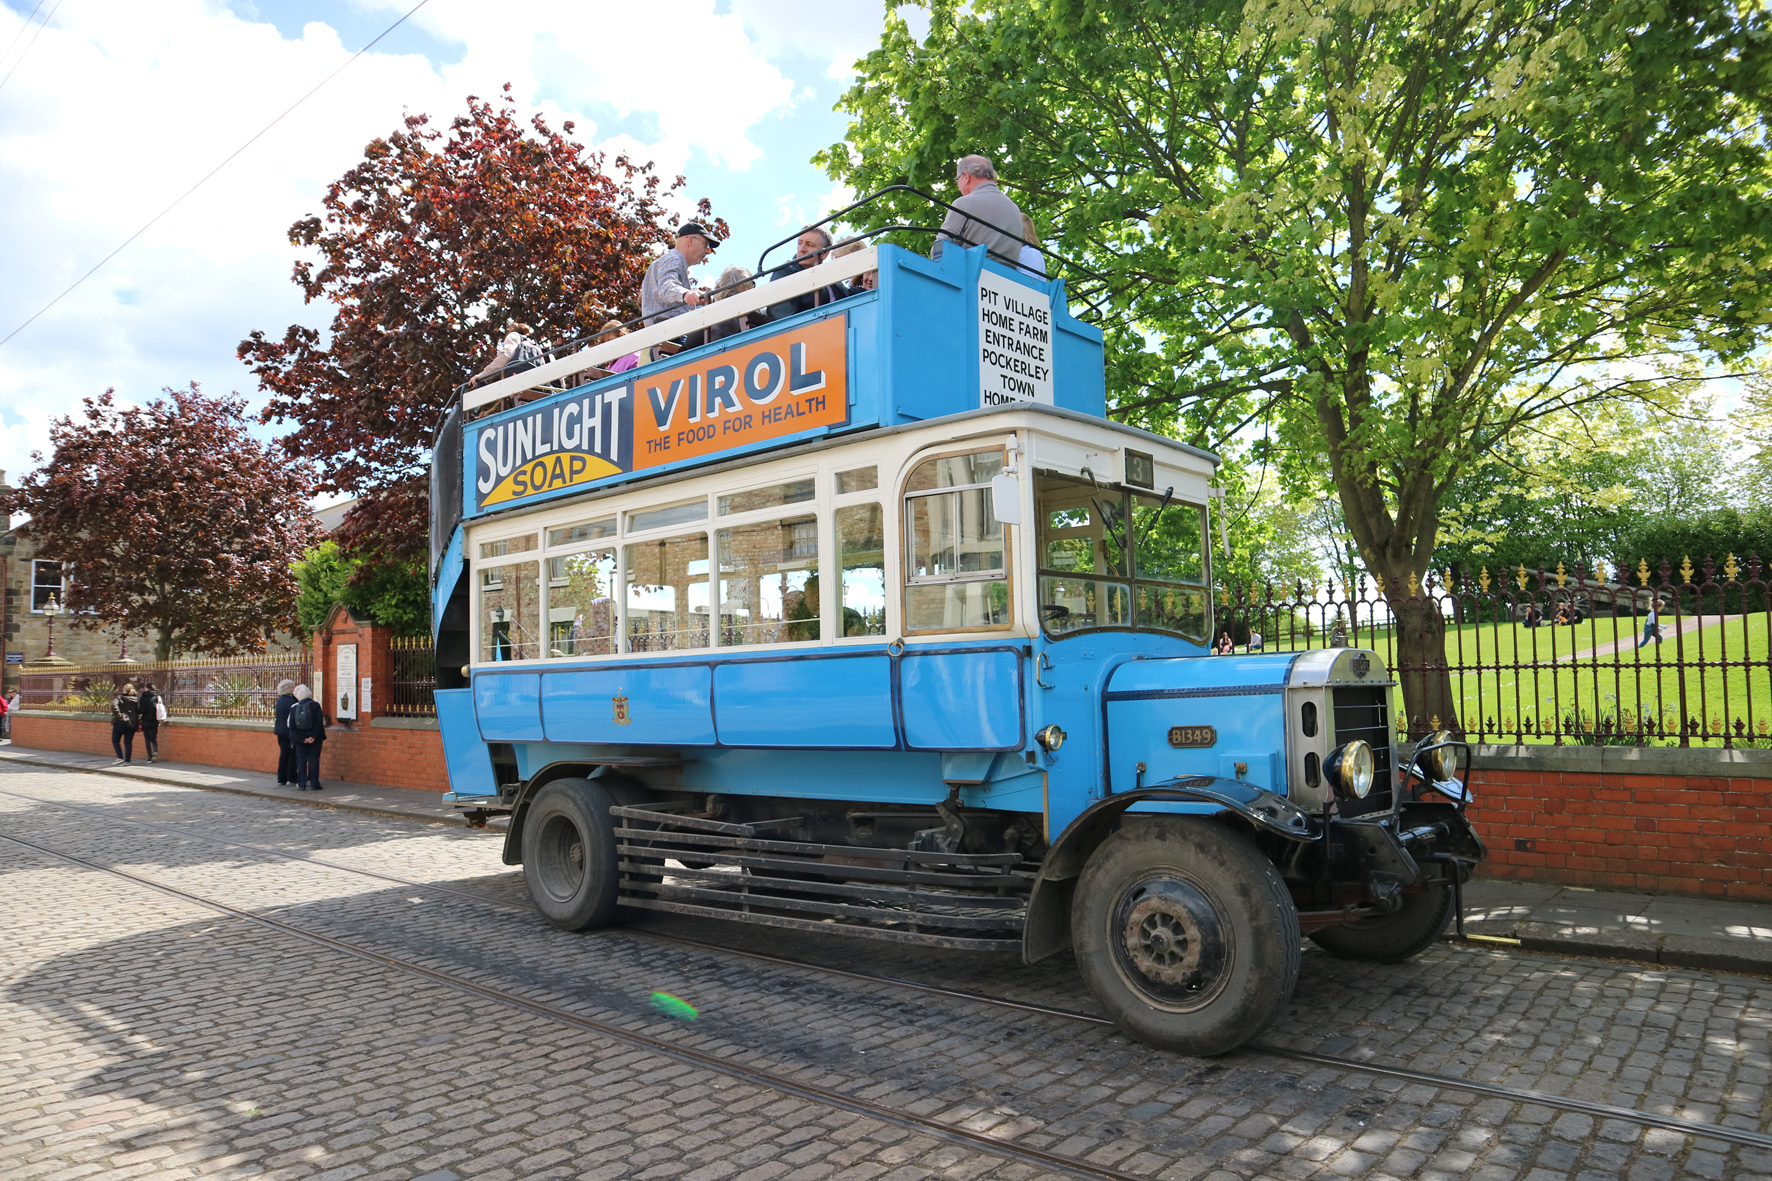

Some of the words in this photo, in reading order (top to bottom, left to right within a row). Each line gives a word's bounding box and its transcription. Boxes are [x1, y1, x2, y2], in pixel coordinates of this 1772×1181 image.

[981, 287, 998, 305] PIT
[1003, 296, 1049, 325] VILLAGE
[982, 308, 1015, 332] HOME
[1019, 321, 1048, 344] FARM
[985, 329, 1045, 362] ENTRANCE
[983, 348, 1049, 382] POCKERLEY
[647, 341, 826, 432] VIROL
[1000, 374, 1035, 398] TOWN
[477, 386, 627, 494] SUNLIGHT
[646, 435, 671, 454] THE
[677, 426, 716, 446] FOOD
[723, 414, 753, 435] FOR
[761, 395, 826, 425] HEALTH
[511, 455, 587, 496] SOAP
[1133, 457, 1143, 481] 3
[1172, 729, 1211, 743] B1349
